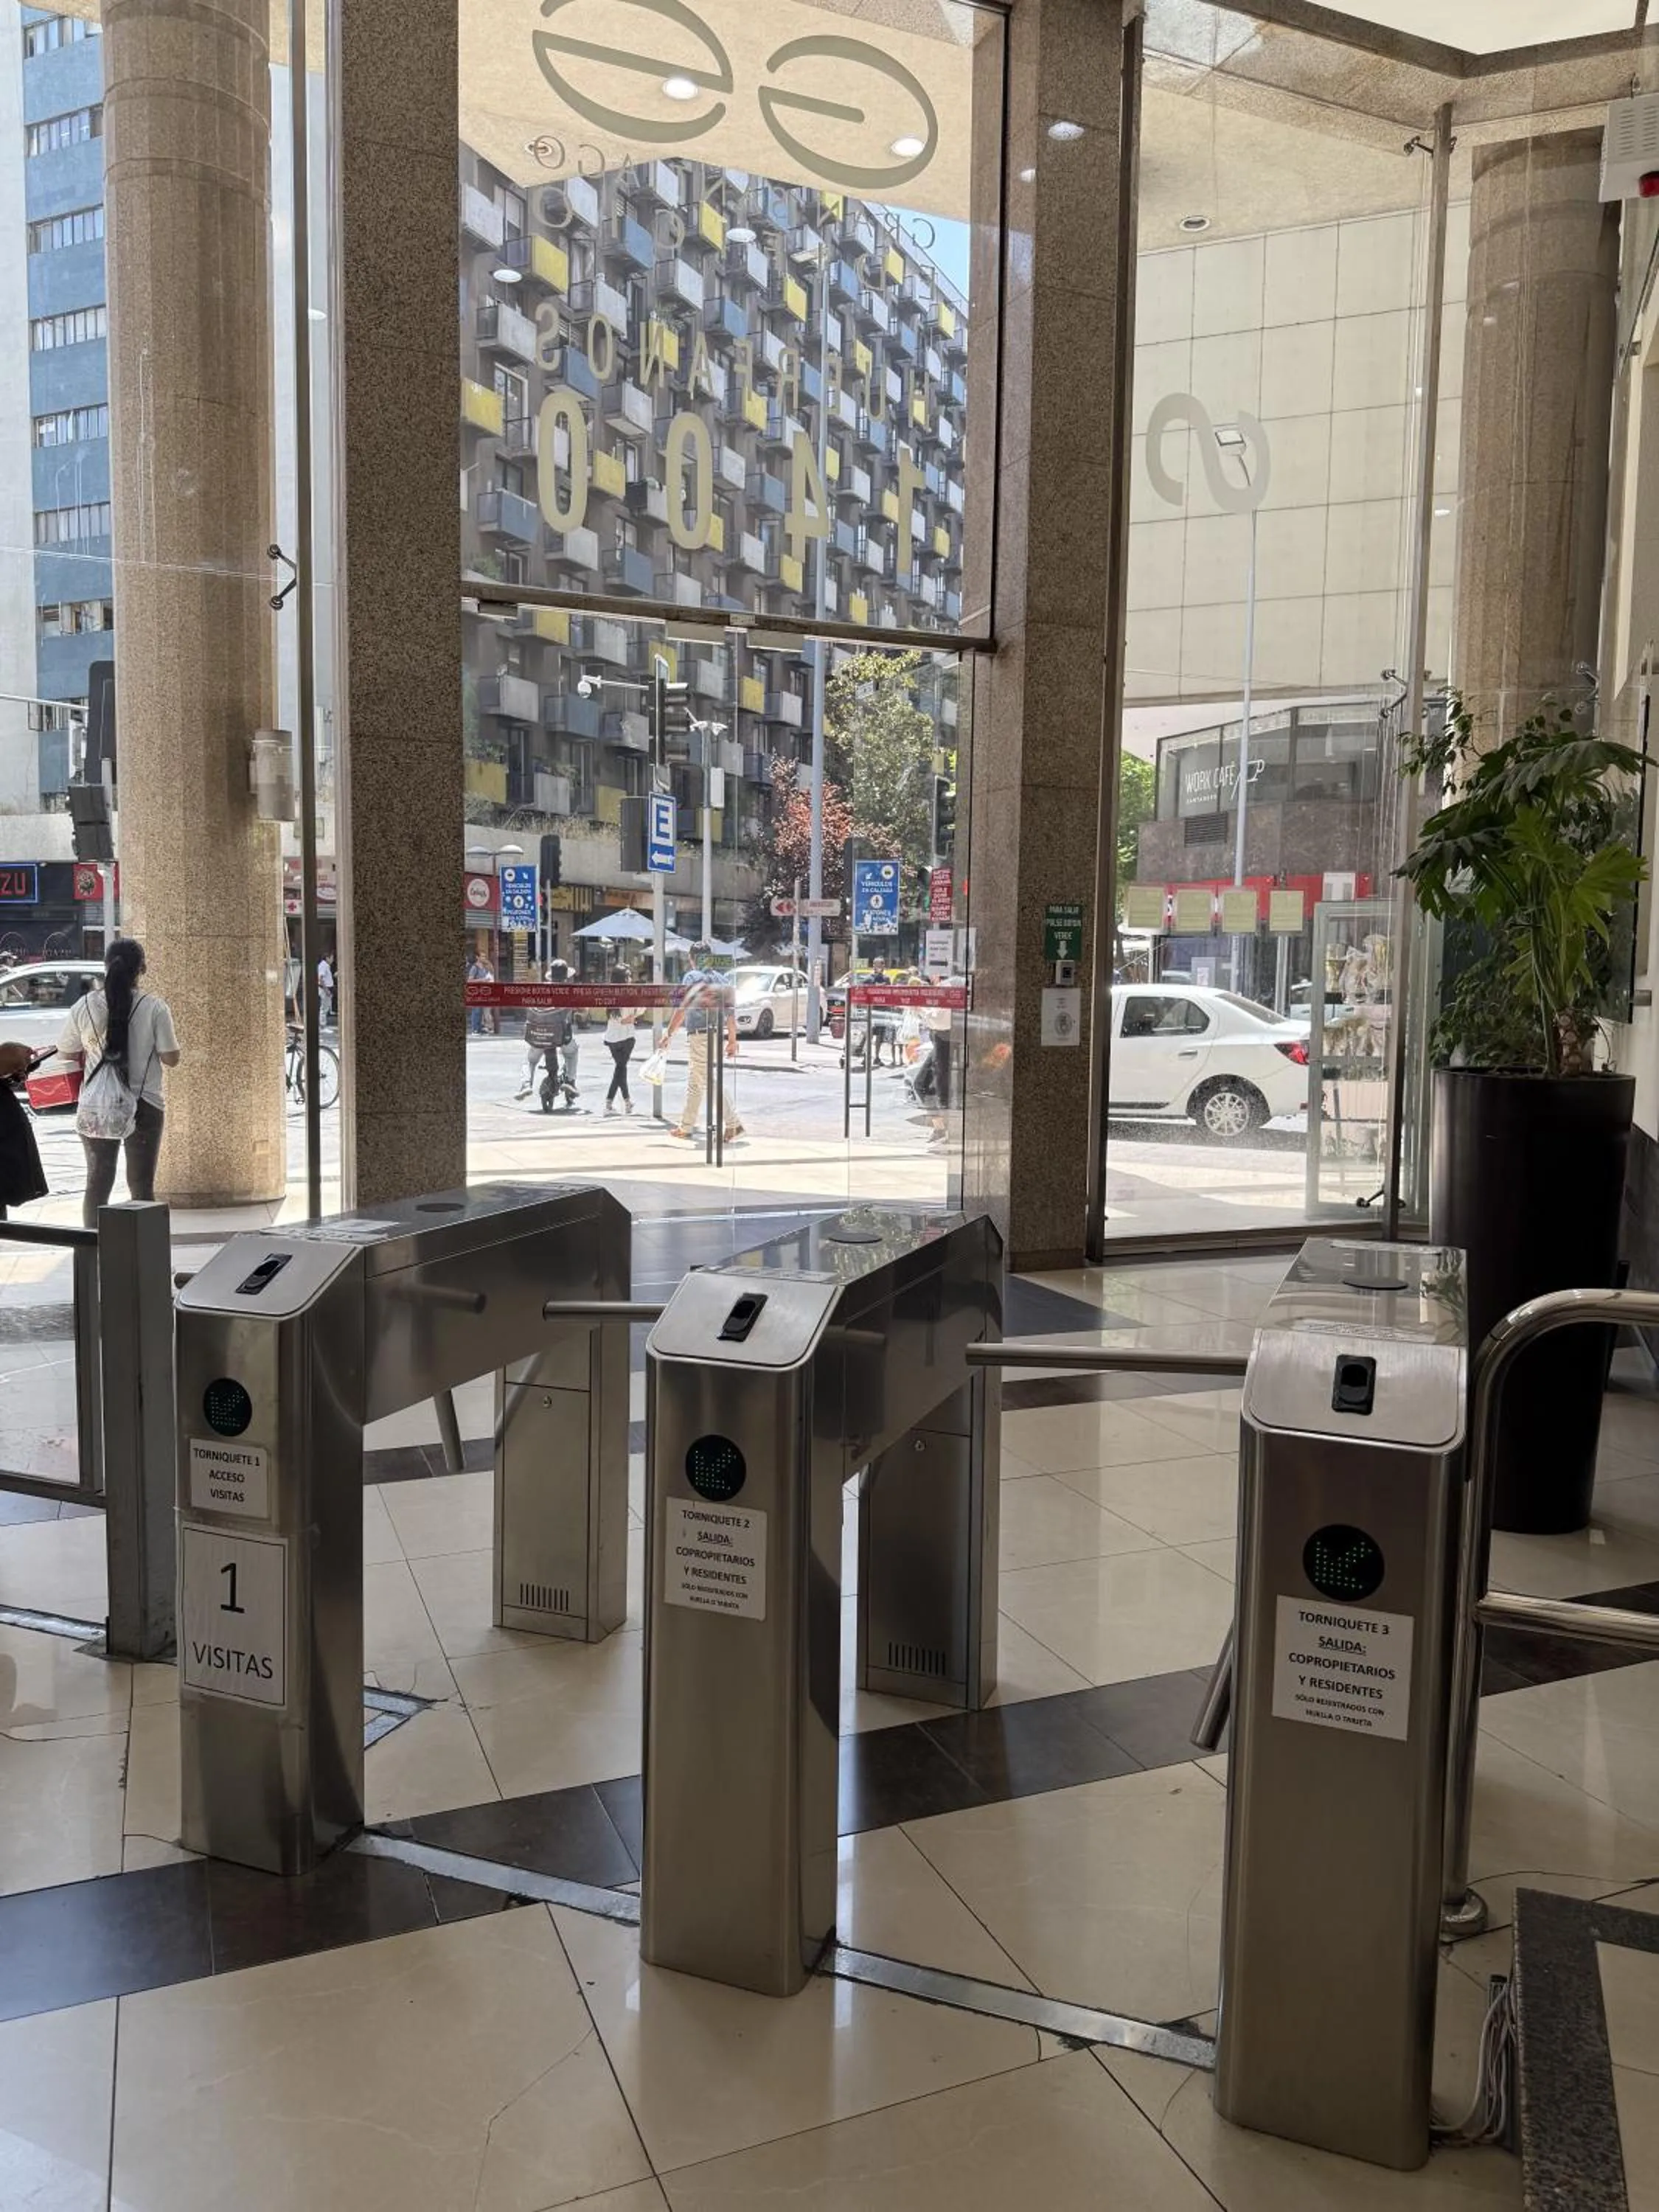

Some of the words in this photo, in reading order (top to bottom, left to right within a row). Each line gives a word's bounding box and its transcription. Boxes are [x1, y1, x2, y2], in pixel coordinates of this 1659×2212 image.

[1185, 769, 1211, 793] WORK
[656, 803, 670, 840] E
[193, 1447, 253, 1465] TORNIQUETE
[254, 1456, 260, 1467] 1
[209, 1469, 245, 1483] ACCESO
[210, 1489, 245, 1502] VISITAS
[681, 1509, 742, 1527] TORNIQUETE
[743, 1519, 750, 1528] 2
[675, 1546, 755, 1567] COPROPIETARIOS
[684, 1565, 689, 1576] Y
[691, 1567, 748, 1585] RESIDENTES
[220, 1562, 246, 1614] 1
[1298, 1610, 1378, 1633] TORNIQUETE
[1382, 1624, 1390, 1635] 3
[1318, 1635, 1366, 1655] SALIDA:
[192, 1641, 273, 1680] VISITAS
[1288, 1652, 1396, 1680] COPROPIETARIOS
[1298, 1674, 1307, 1686] Y
[1310, 1677, 1383, 1700] RESIDENTES
